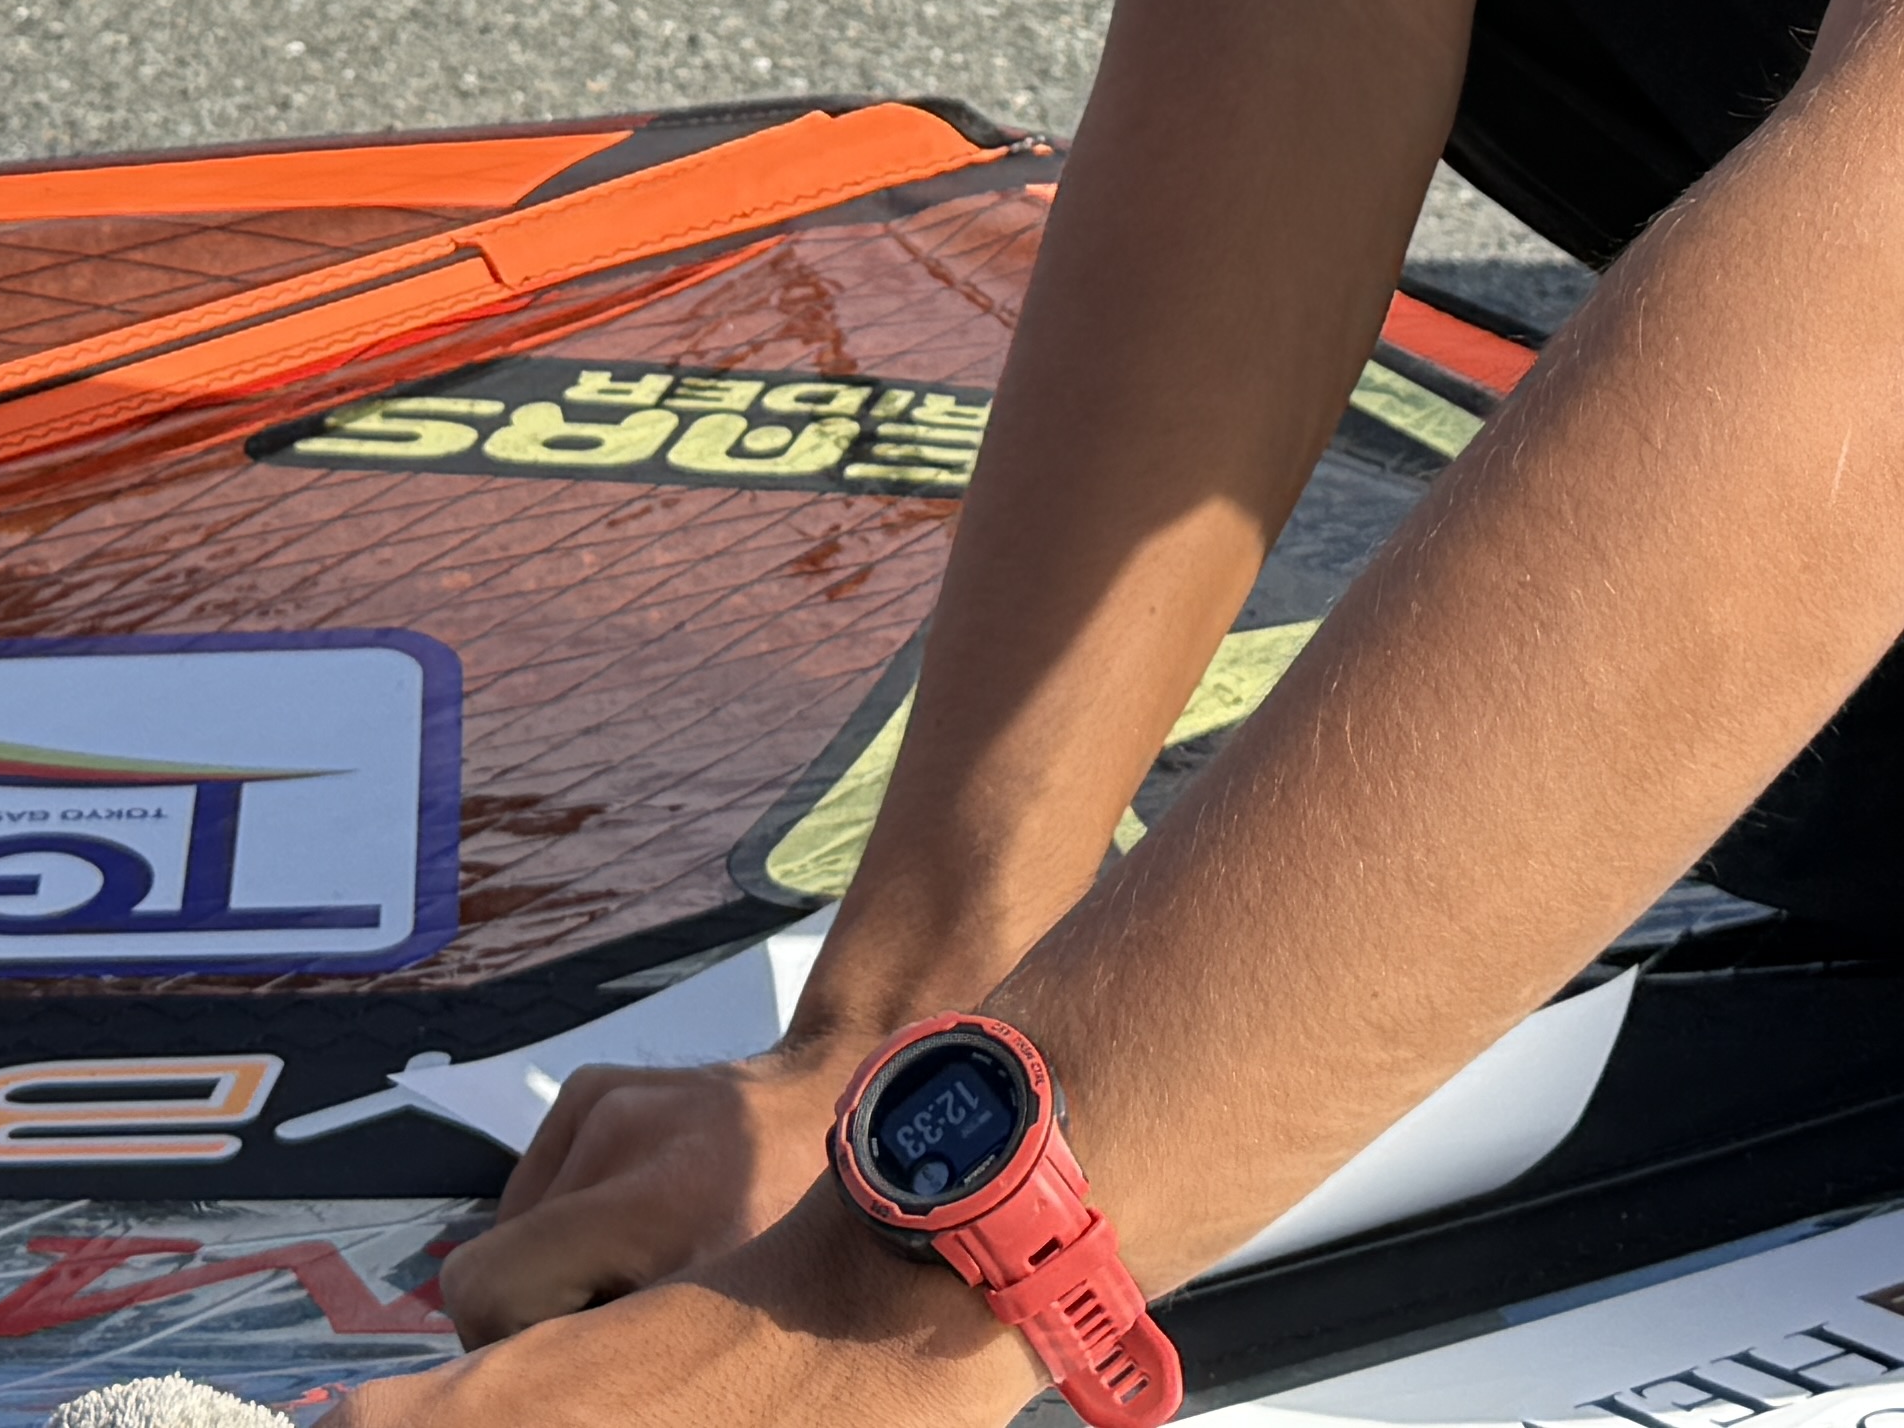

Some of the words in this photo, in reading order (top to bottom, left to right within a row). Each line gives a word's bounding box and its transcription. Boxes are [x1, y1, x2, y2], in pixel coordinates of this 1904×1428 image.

[565, 370, 992, 431] RIDER
[59, 806, 168, 823] TOKYO
[896, 1081, 980, 1160] 12:33
